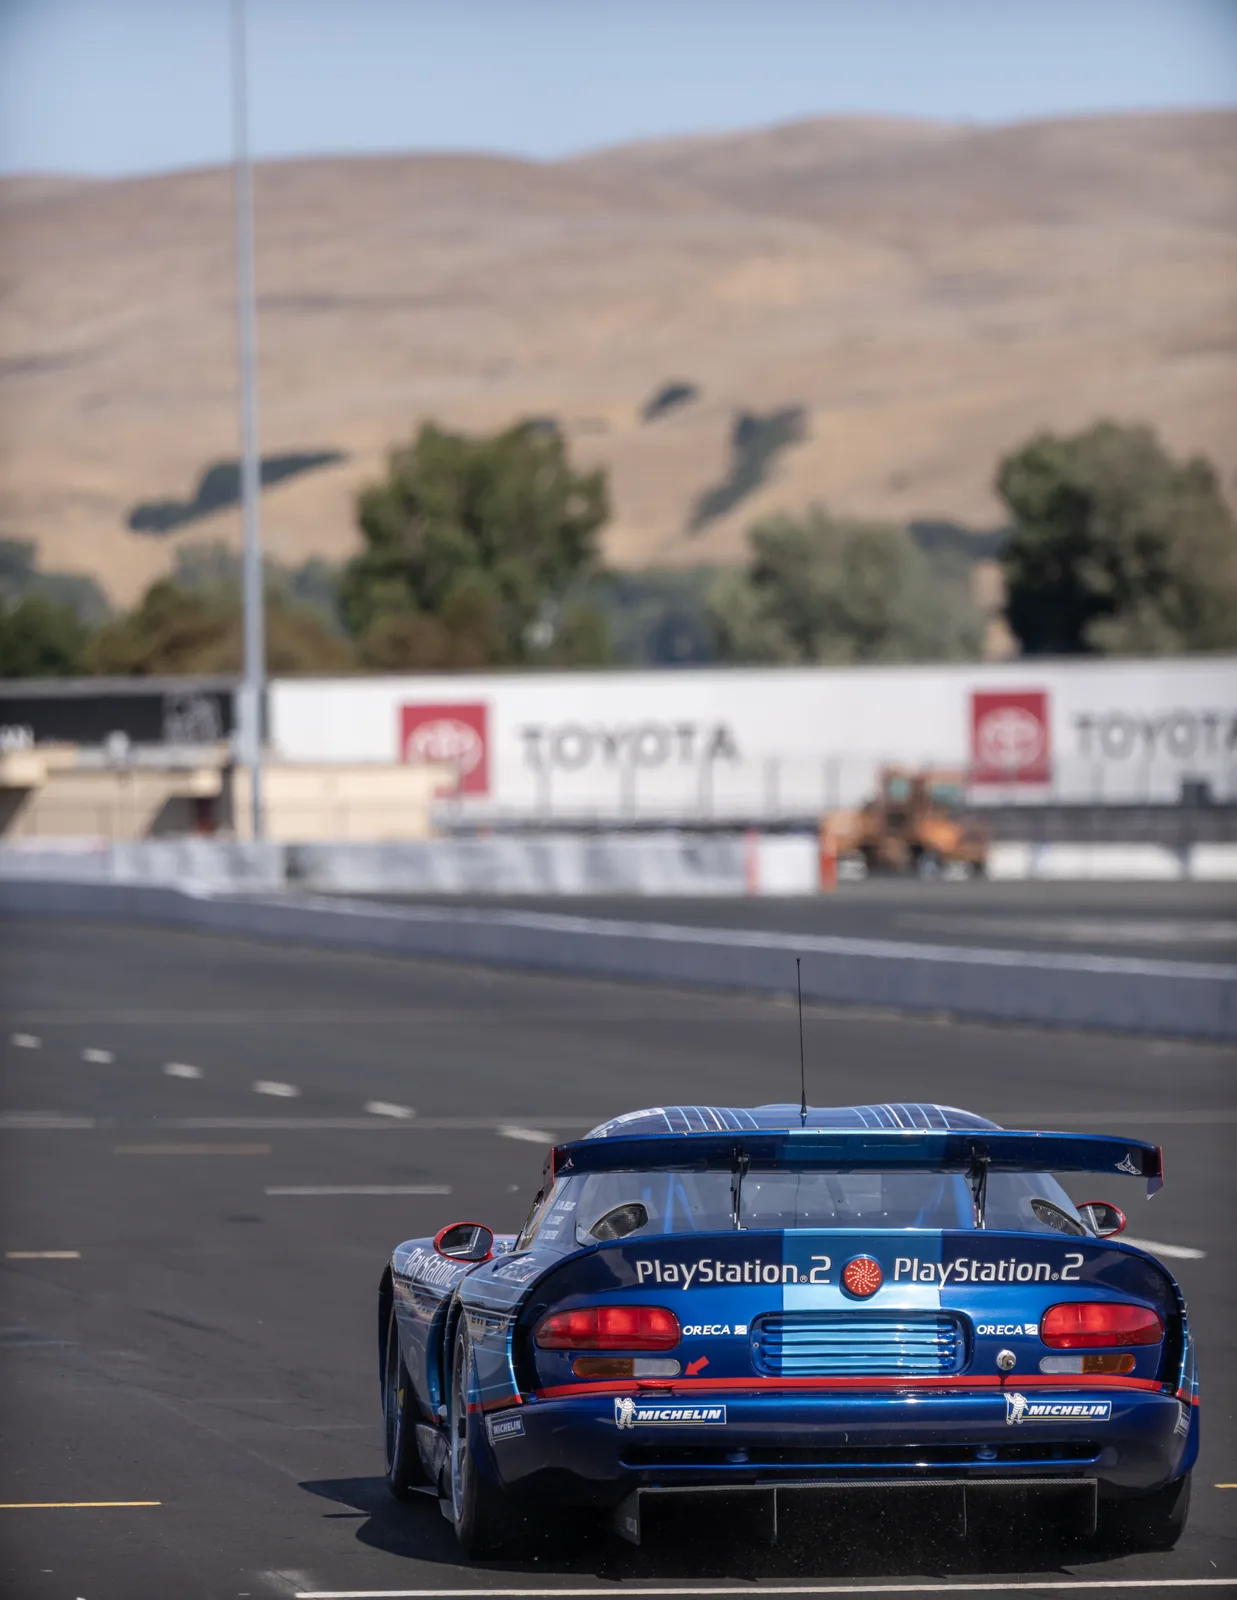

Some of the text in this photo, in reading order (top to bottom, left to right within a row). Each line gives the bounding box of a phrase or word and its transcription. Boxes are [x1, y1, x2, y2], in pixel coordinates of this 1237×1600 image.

[520, 720, 742, 770] TOYOTA
[682, 1324, 731, 1336] ORECA
[976, 1324, 1024, 1335] ORECA
[637, 1409, 722, 1420] MICHELIN
[1028, 1405, 1108, 1416] MICHELIN
